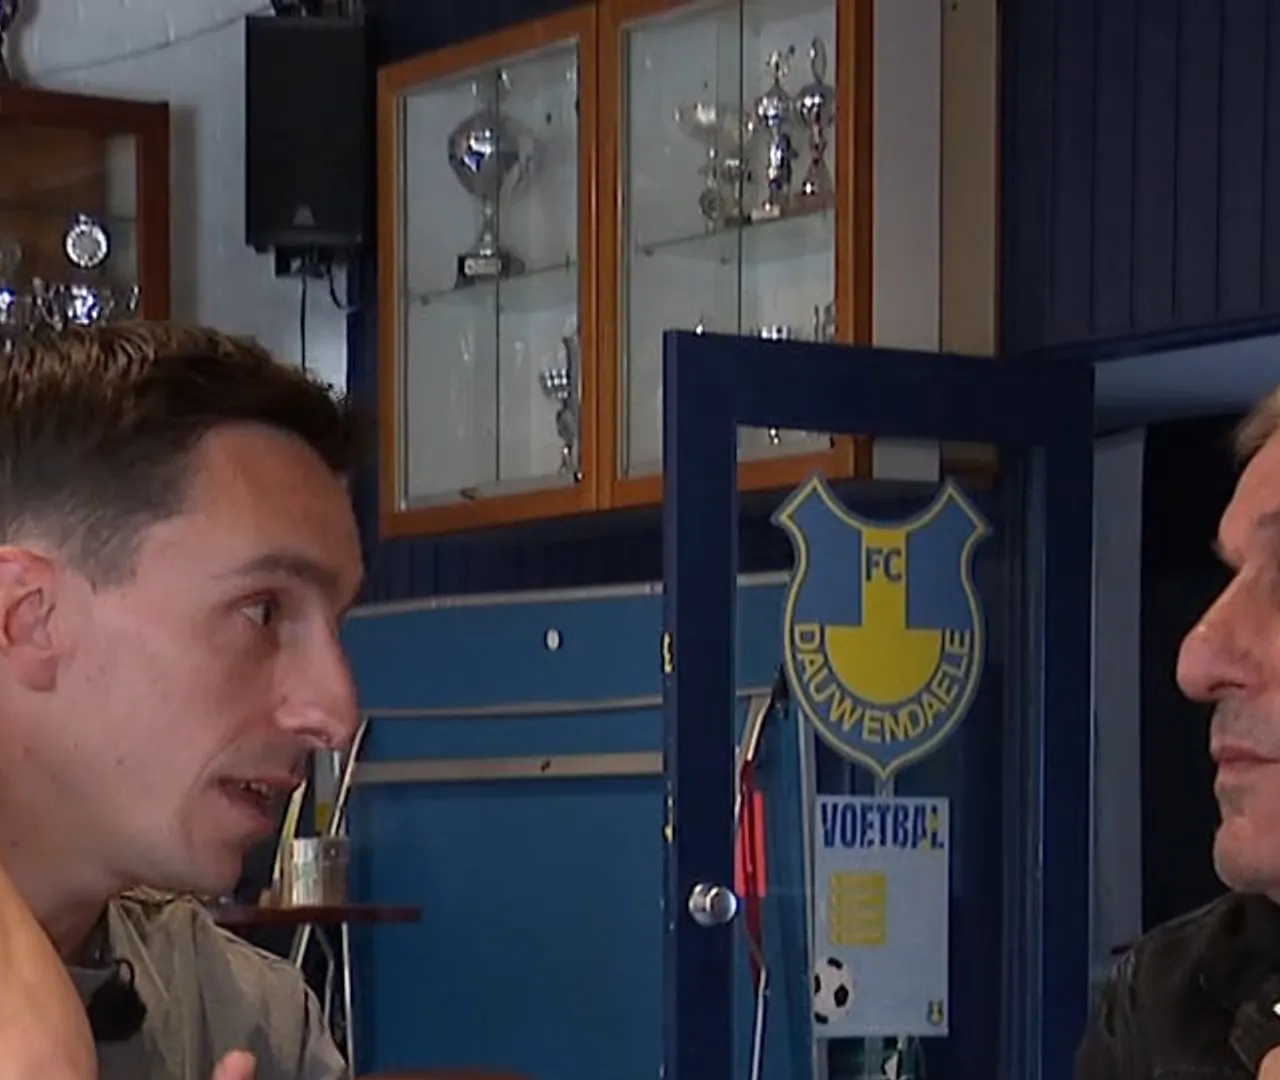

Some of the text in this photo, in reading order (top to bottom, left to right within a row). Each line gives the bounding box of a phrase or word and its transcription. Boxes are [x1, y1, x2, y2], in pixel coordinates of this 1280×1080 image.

[865, 547, 903, 583] FC
[794, 623, 970, 744] DAUWENDAELE
[821, 802, 946, 850] VOETBAL
